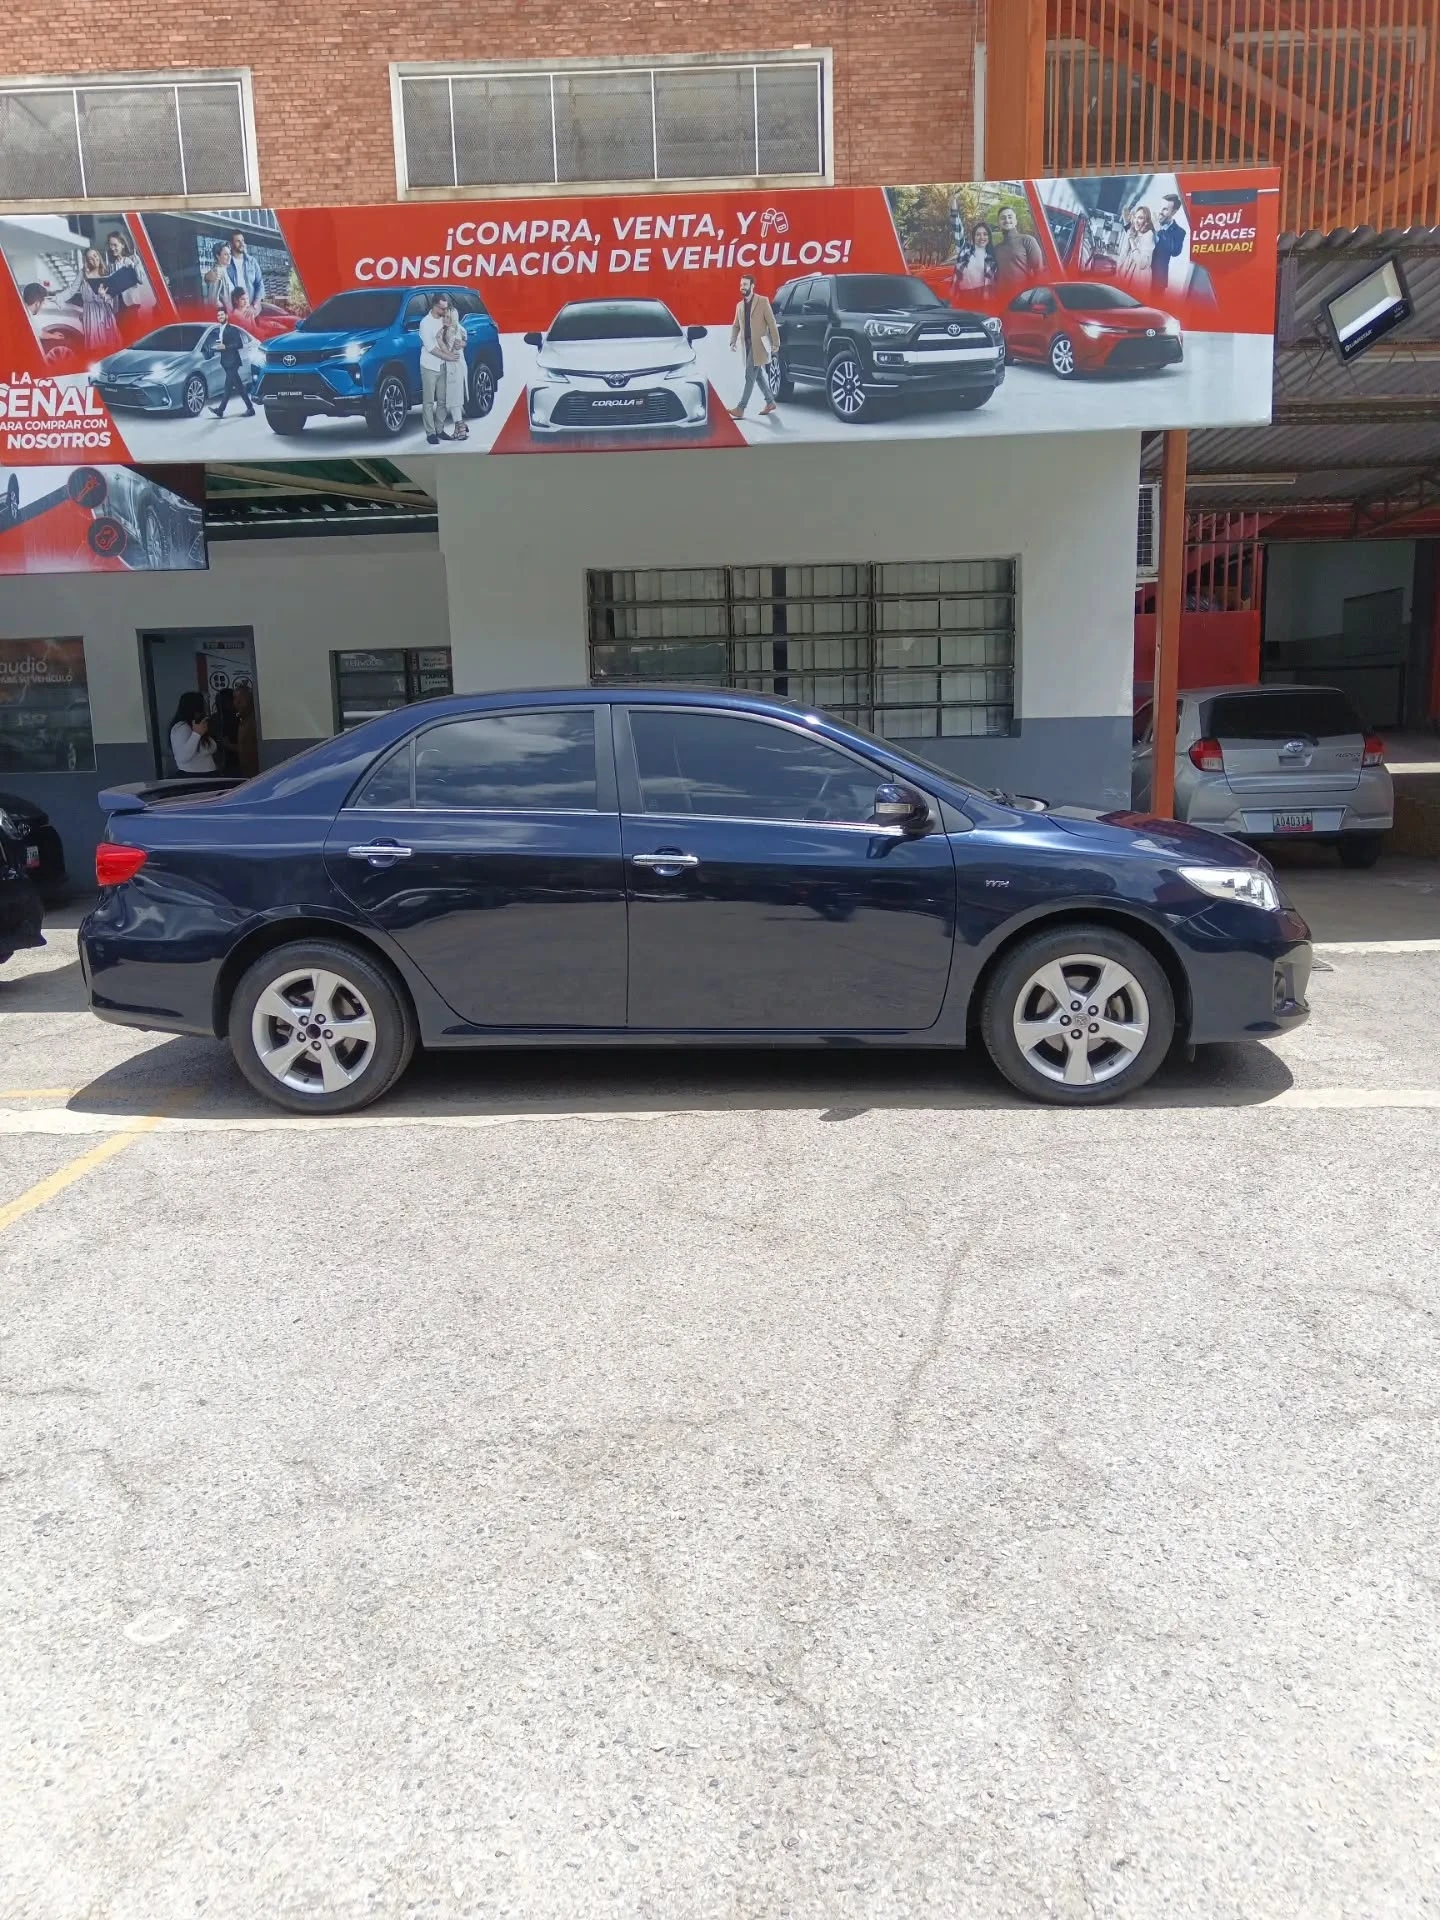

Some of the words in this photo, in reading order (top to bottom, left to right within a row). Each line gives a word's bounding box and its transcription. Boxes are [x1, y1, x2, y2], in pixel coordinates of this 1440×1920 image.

[1199, 208, 1243, 228] ¡AQUÍ
[446, 218, 601, 251] ¡COMPRA,
[612, 212, 724, 241] VENTA,
[735, 211, 757, 235] Y
[1192, 229, 1210, 241] LO
[1210, 227, 1256, 240] HACES
[1192, 241, 1254, 254] REALIDAD!
[354, 245, 599, 281] CONSIGNACIÓN
[608, 248, 651, 273] DE
[662, 238, 852, 271] VEHÍCULOS!
[11, 371, 32, 385] LA
[591, 399, 636, 407] COROLLA
[0, 420, 23, 431] ARA
[24, 419, 82, 431] COMPRAR
[83, 418, 108, 429] CON
[7, 431, 112, 450] NOSOTROS
